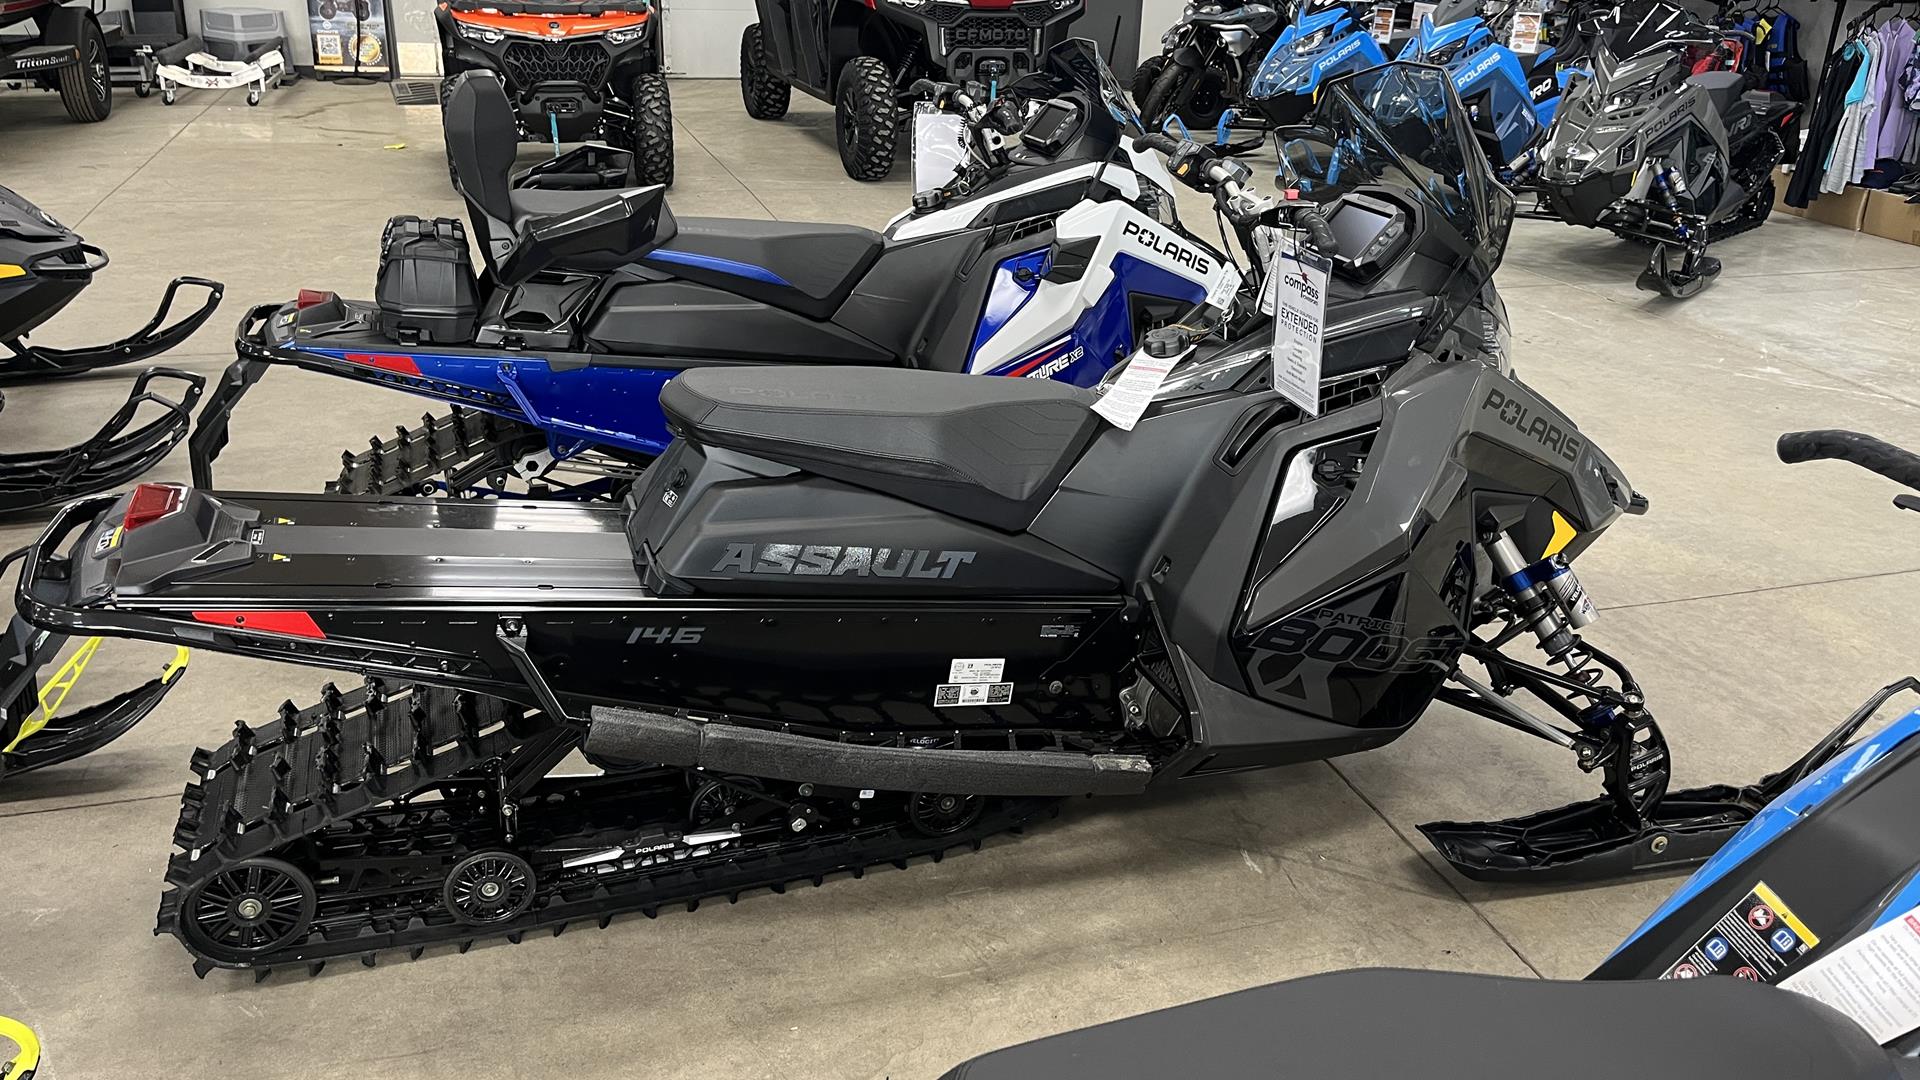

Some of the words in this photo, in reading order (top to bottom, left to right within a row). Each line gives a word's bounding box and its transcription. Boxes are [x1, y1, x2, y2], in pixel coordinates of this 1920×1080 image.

[956, 28, 1026, 41] CFMOTO
[15, 57, 50, 69] Triton
[1318, 40, 1361, 71] POLARIS
[1457, 52, 1501, 87] POLARIS
[1645, 96, 1696, 139] POLARIS
[1122, 220, 1210, 275] POLARIS
[1284, 275, 1319, 300] compass
[1281, 307, 1319, 335] EXTENDED
[1281, 319, 1318, 344] PROTECTION
[1069, 345, 1084, 364] X2
[1481, 388, 1580, 462] POLARIS
[711, 542, 977, 579] ASSAULT
[626, 626, 706, 644] 146
[1318, 608, 1408, 636] PATRIOT
[1630, 753, 1664, 772] POLARIS
[635, 842, 675, 855] POLARIS
